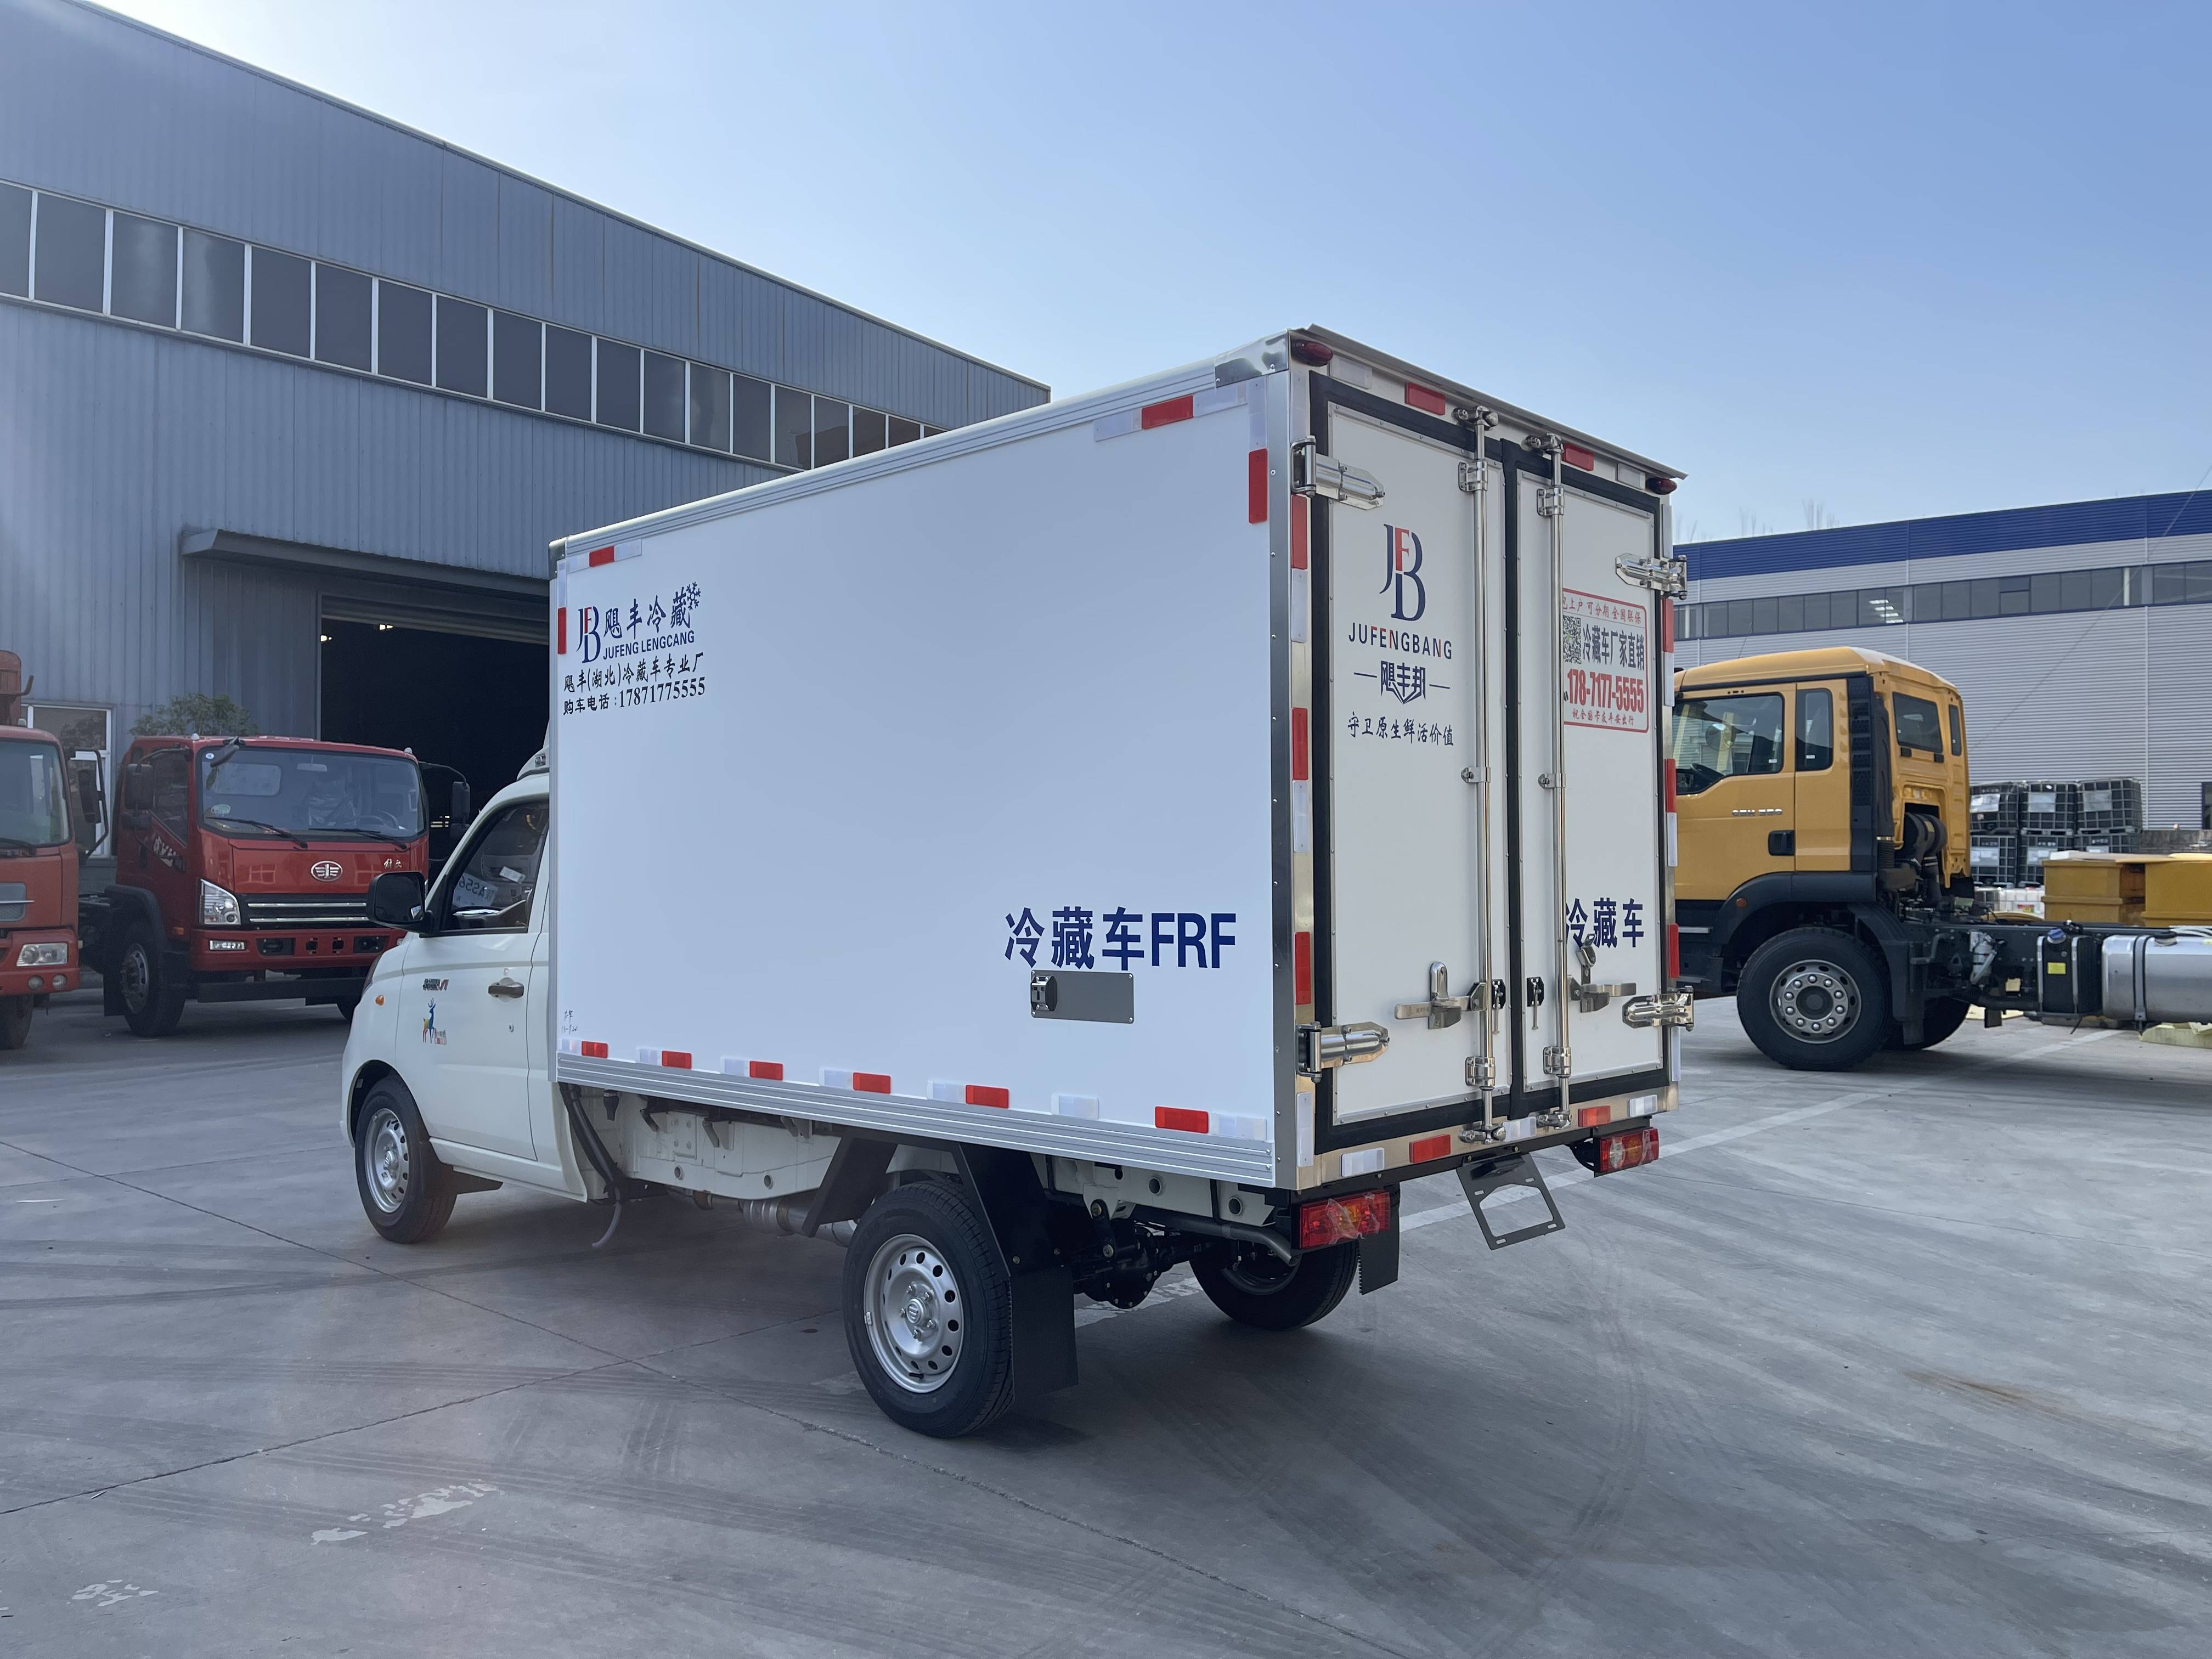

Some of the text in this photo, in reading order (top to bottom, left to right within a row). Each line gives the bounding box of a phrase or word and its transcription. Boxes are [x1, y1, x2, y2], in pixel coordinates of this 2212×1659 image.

[603, 630, 695, 660] JUFENG LENGCANG
[1348, 622, 1452, 659] JUFENGBANG
[1583, 623, 1645, 671] 冷藏车厂家直销
[1567, 668, 1644, 713] 178-7177-5555
[1347, 711, 1454, 746] 守卫原生鲜活价值
[1566, 898, 1645, 949] 冷藏车
